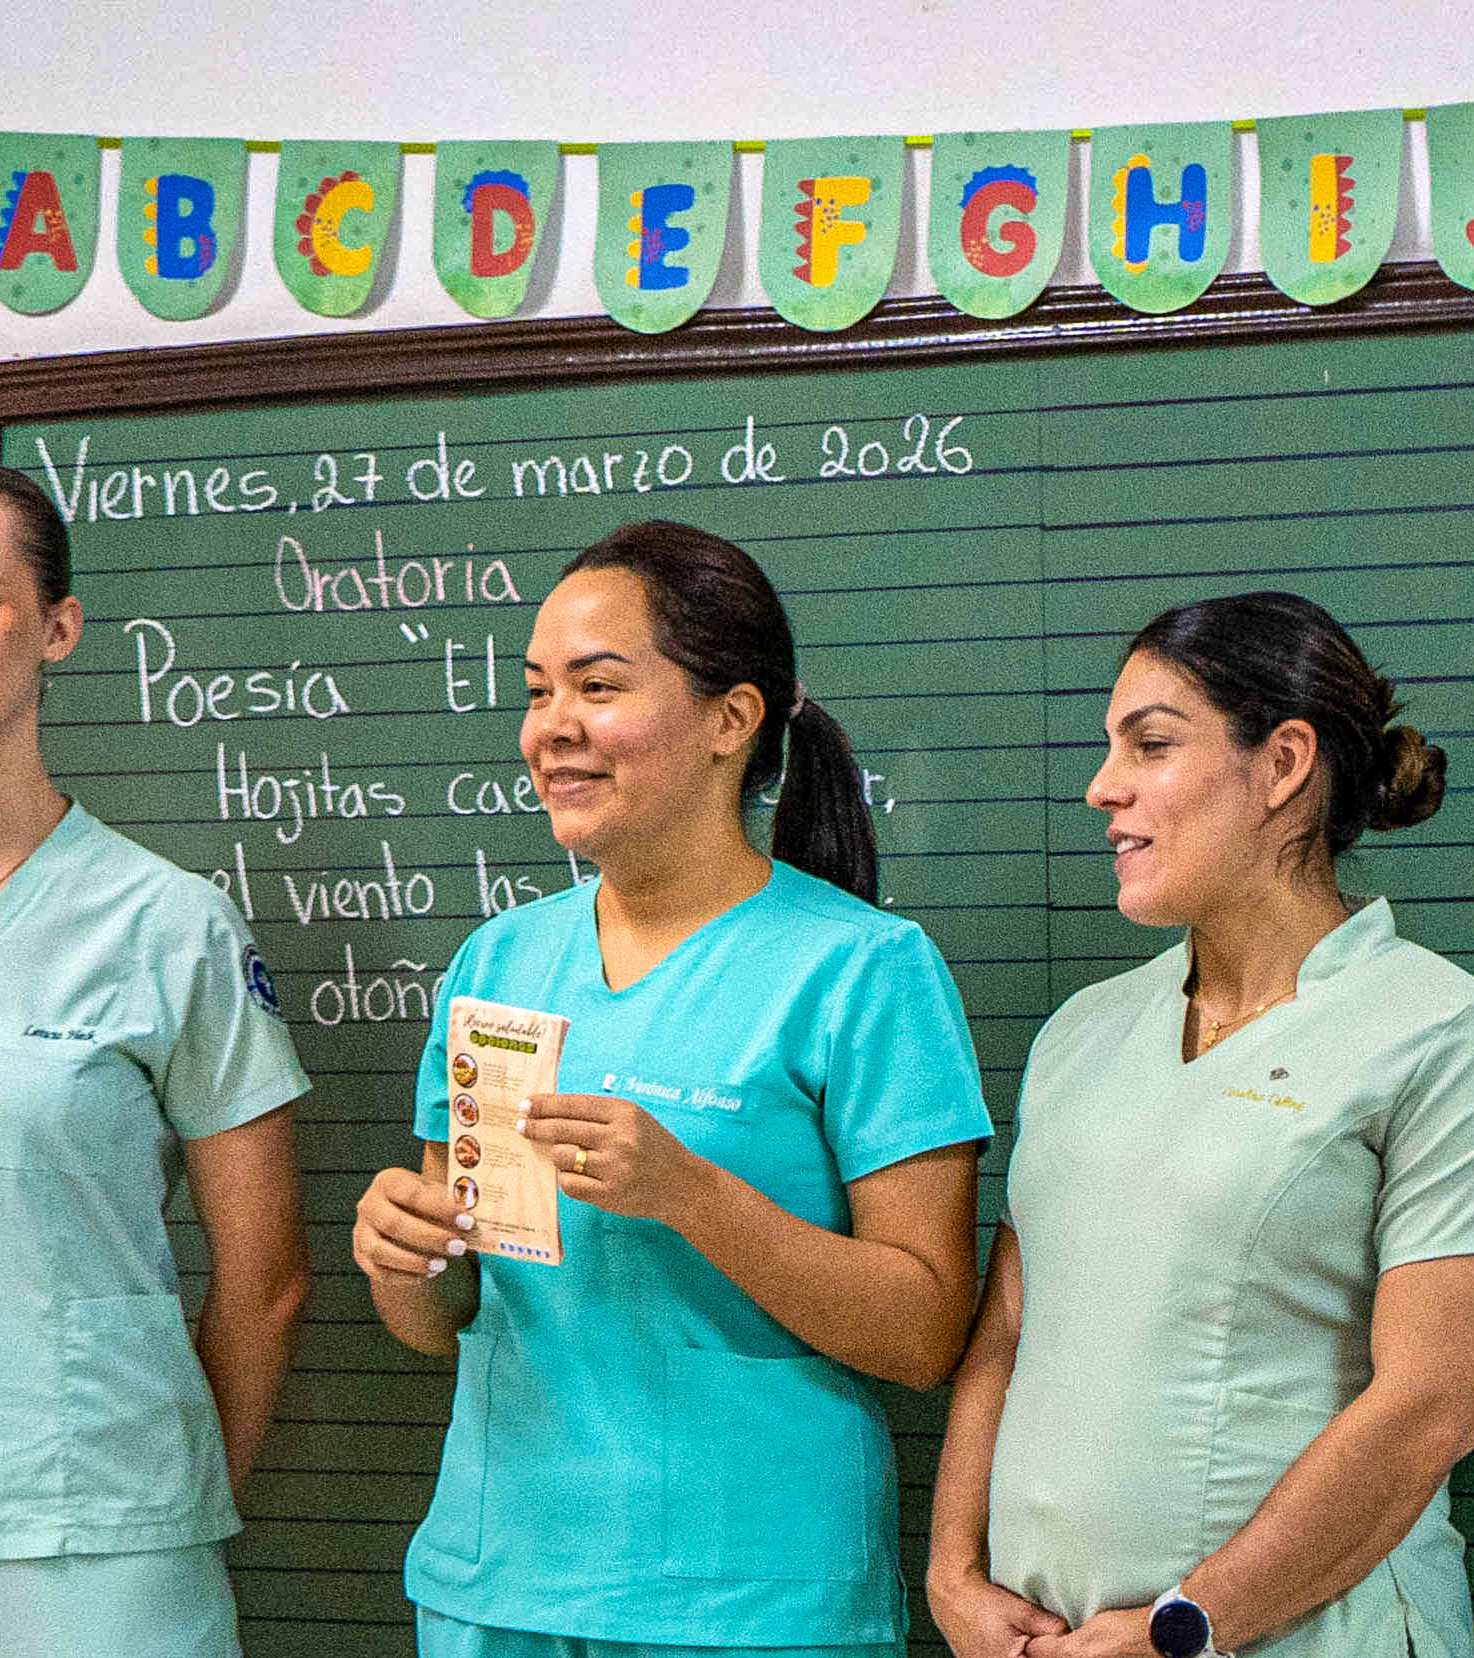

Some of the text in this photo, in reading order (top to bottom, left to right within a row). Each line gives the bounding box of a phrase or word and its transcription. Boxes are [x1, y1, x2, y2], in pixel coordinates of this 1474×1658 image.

[155, 173, 217, 282] B
[310, 177, 375, 277] C
[470, 185, 534, 278] D
[639, 183, 696, 290] E
[808, 176, 872, 288] F
[960, 182, 1038, 278] G
[1126, 162, 1208, 263] H
[1308, 153, 1338, 264] I
[35, 413, 974, 524] Viernes, 27 de marzo de 2026
[274, 528, 522, 612] Oratoria
[124, 618, 351, 727] Poesía
[216, 742, 548, 844] Hojitas cae
[283, 840, 434, 926] viento
[475, 848, 544, 918] las
[310, 942, 448, 1026] otoñ
